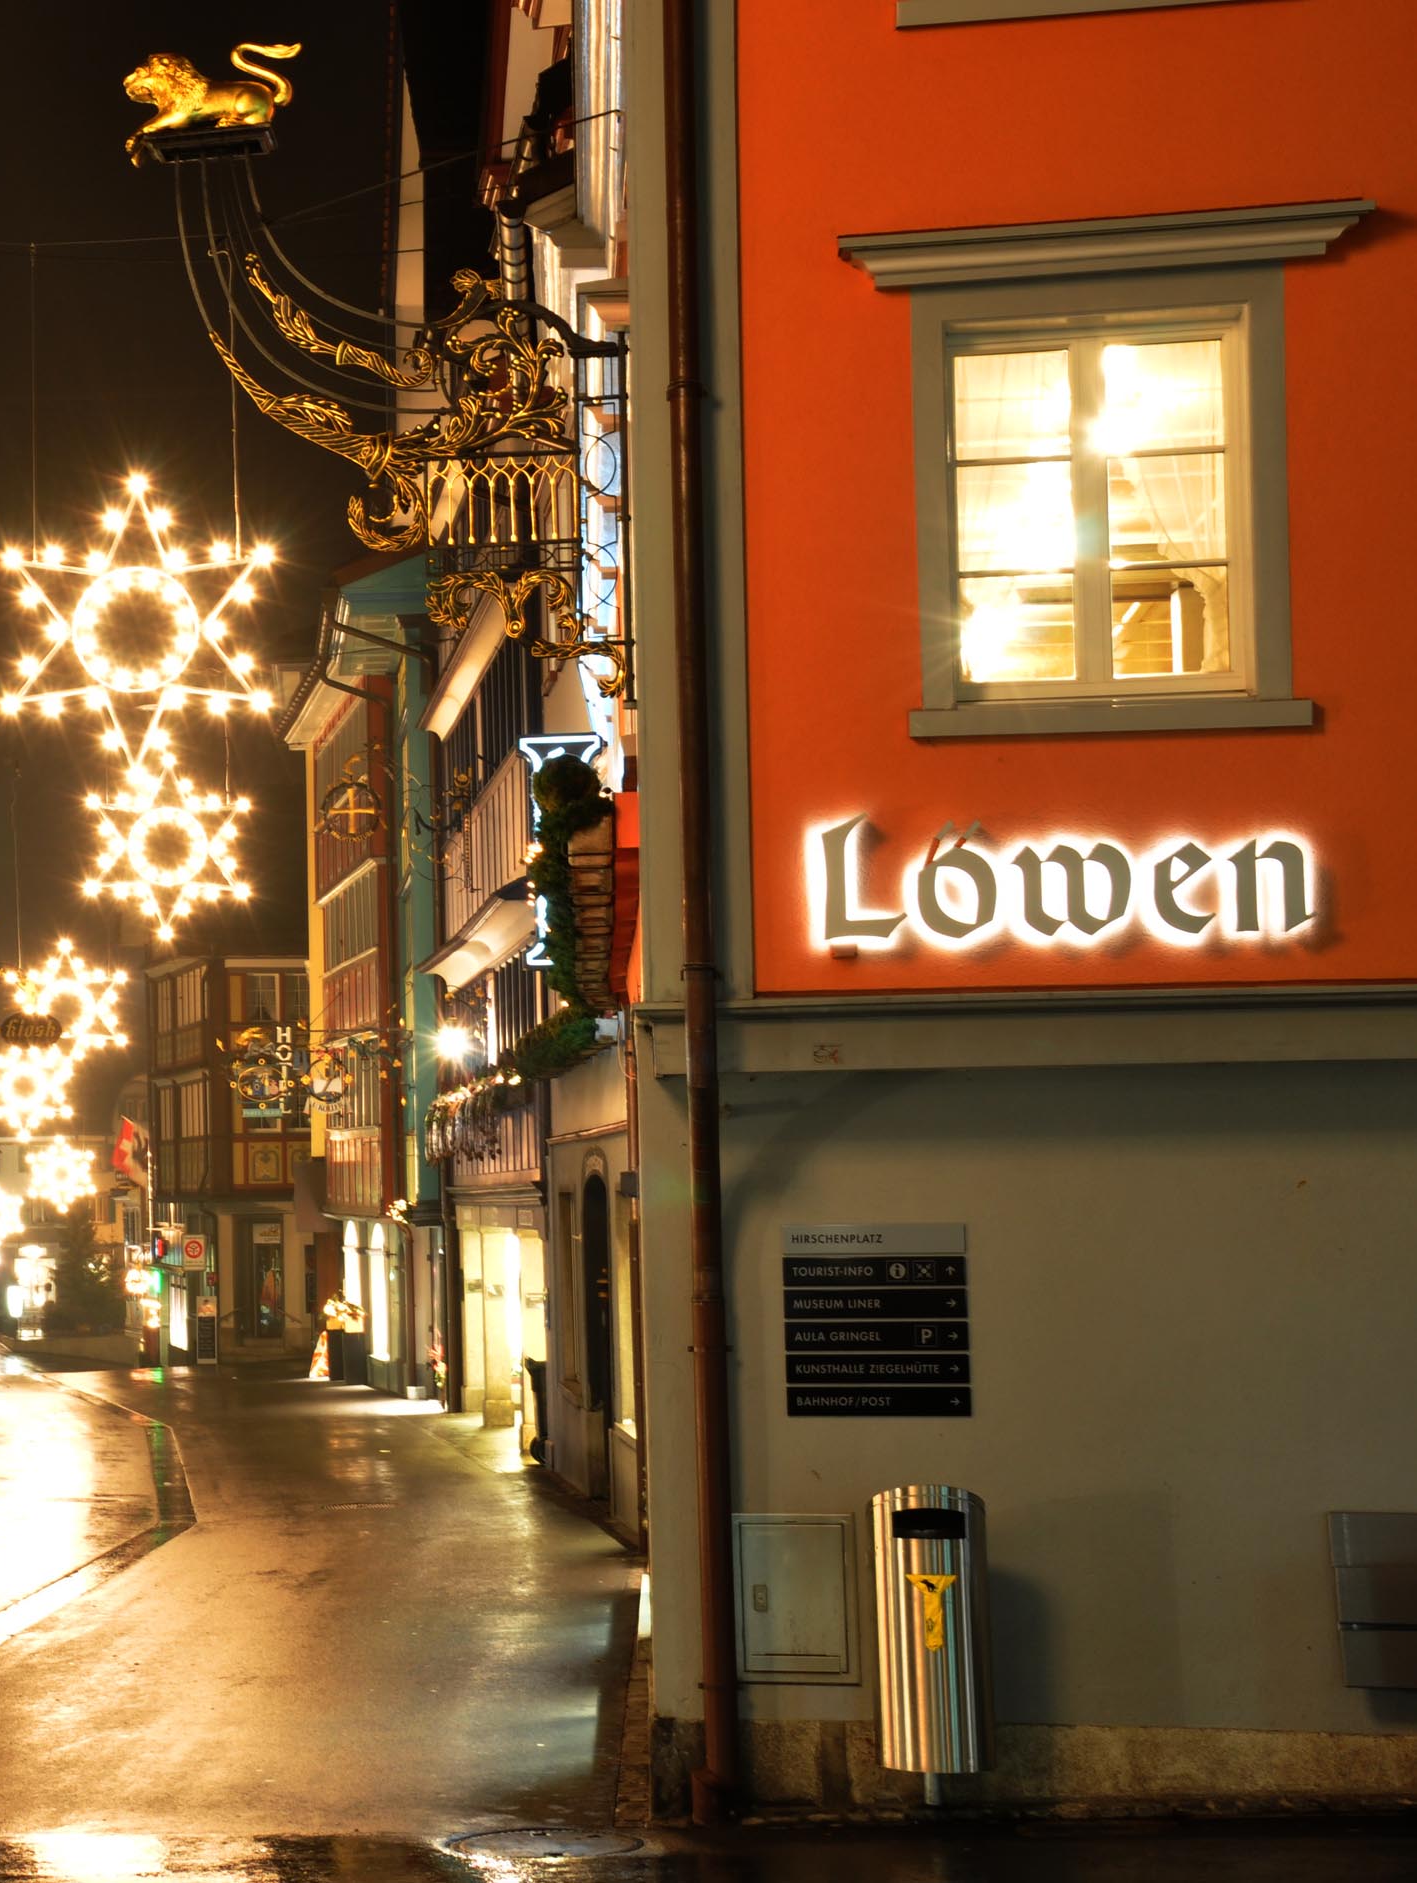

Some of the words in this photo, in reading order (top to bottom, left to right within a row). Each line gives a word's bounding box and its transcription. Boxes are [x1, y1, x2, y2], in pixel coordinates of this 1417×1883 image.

[822, 813, 1317, 940] Löwen
[791, 1234, 882, 1244] HIRSCHENPLATZ
[792, 1266, 873, 1277] TOURIST-INFO
[793, 1299, 844, 1309] MUSEUM
[848, 1299, 881, 1309] LINER
[794, 1331, 825, 1341] AULA
[829, 1331, 881, 1342] GRINGEL
[921, 1328, 932, 1344] P
[795, 1364, 865, 1374] KUNSTHALLE
[869, 1361, 940, 1374] ZIEGELHÜTTE
